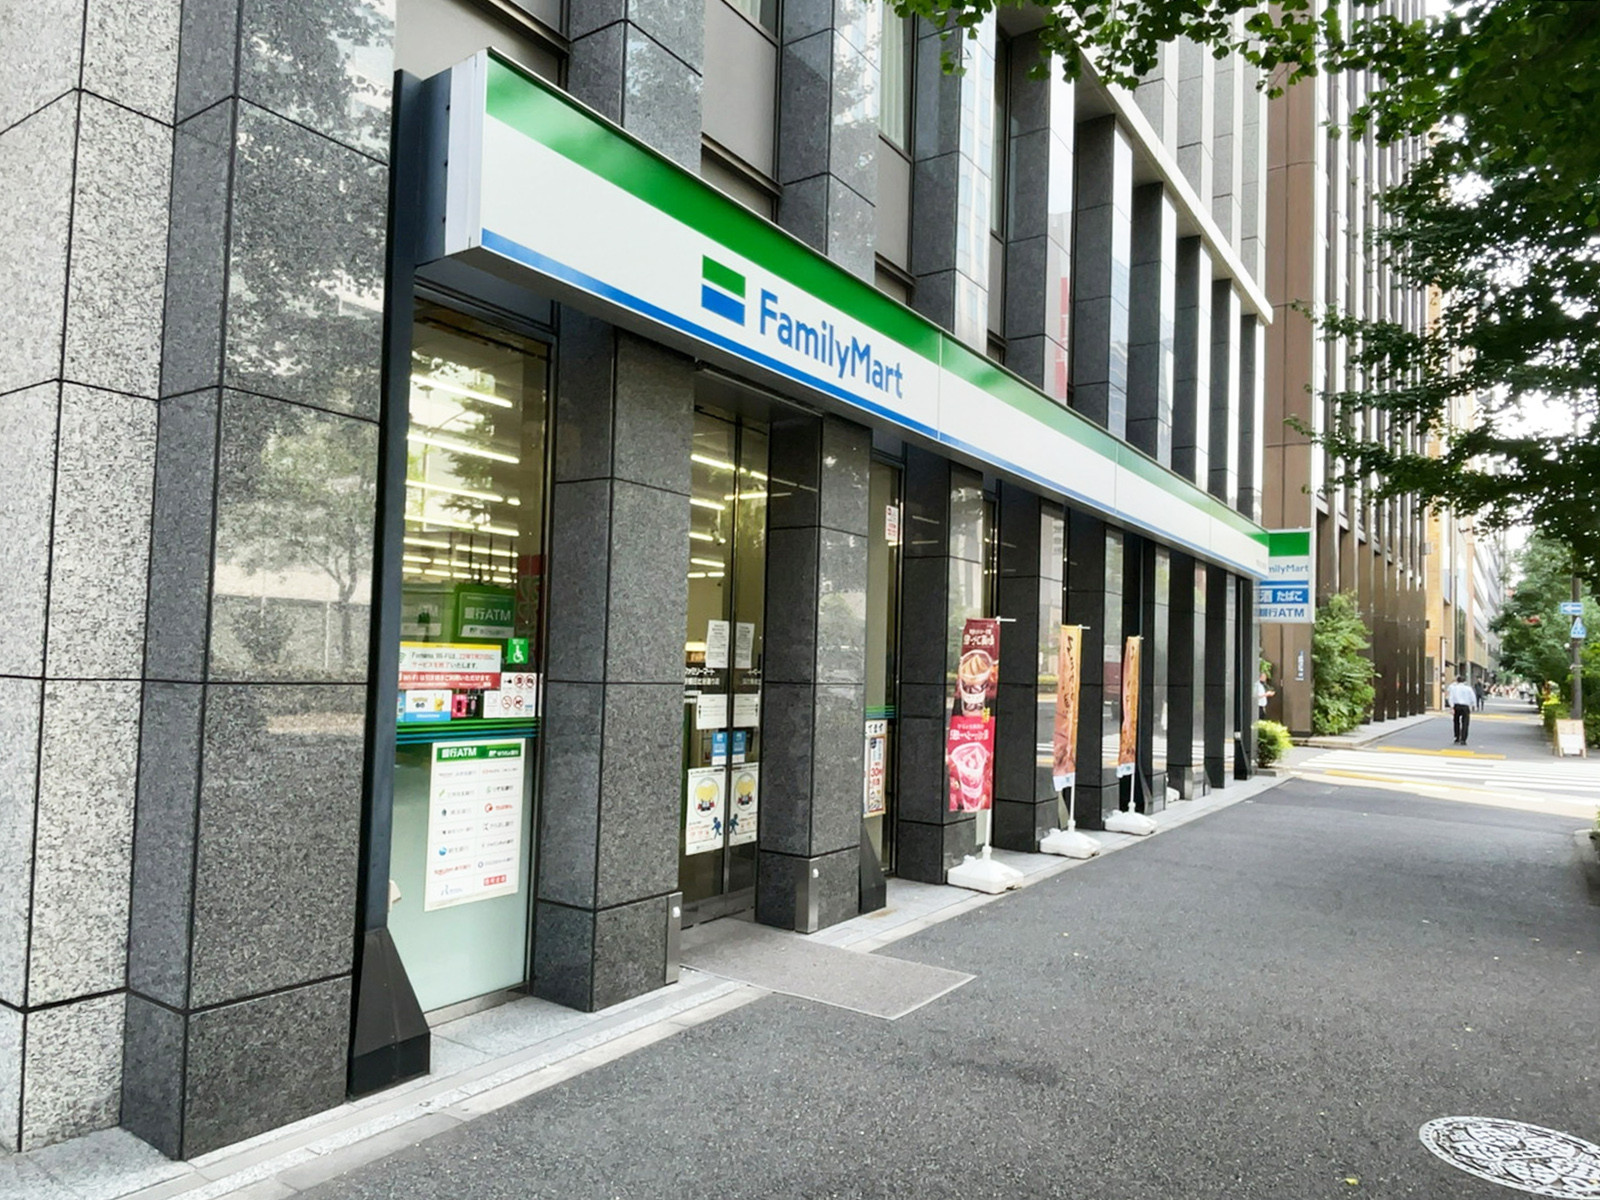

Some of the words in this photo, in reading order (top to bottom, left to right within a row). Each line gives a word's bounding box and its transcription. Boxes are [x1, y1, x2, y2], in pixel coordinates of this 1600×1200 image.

[760, 288, 903, 399] FamilyMart
[1277, 590, 1303, 602] たばこ
[464, 606, 511, 621] 銀行ATM
[441, 747, 477, 759] 銀行ATM
